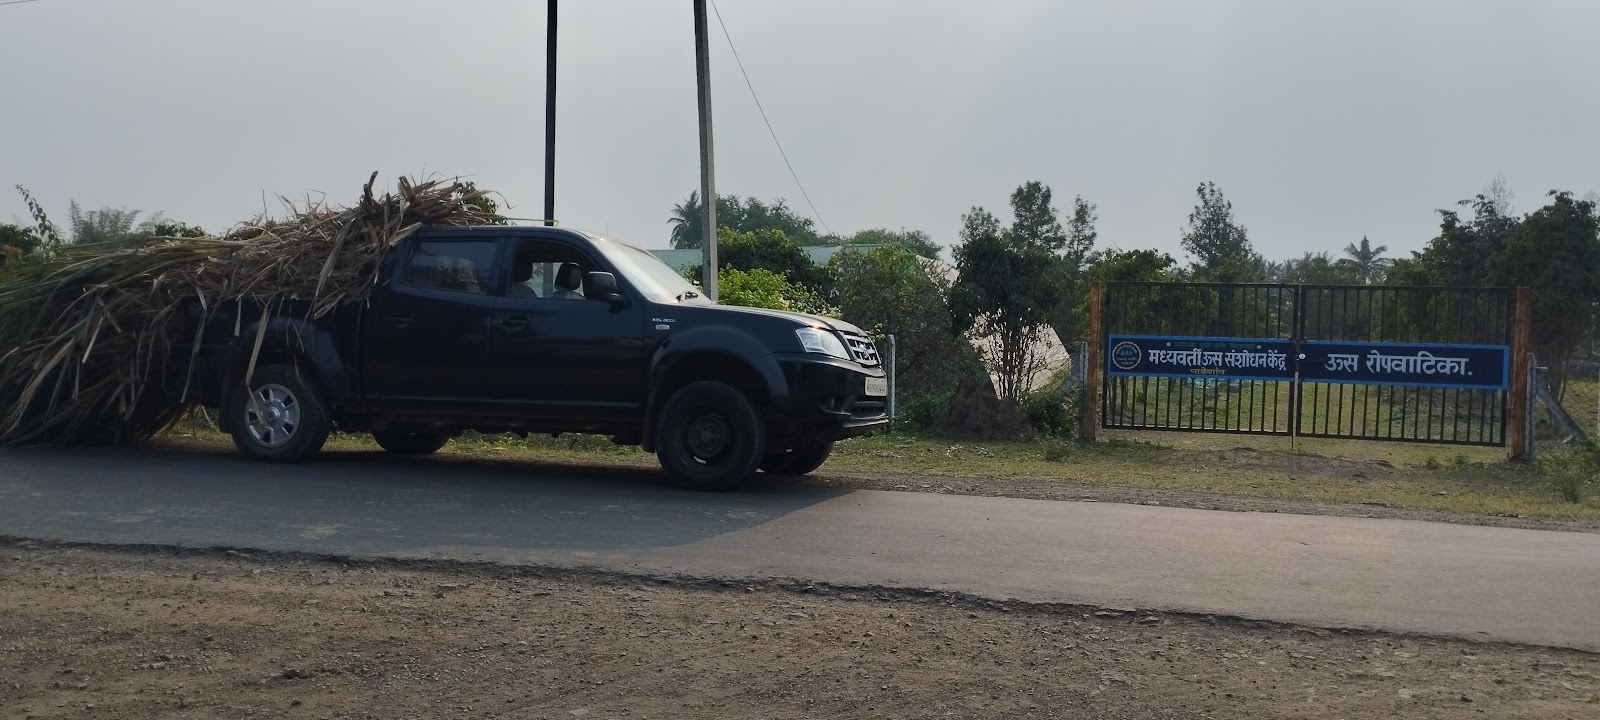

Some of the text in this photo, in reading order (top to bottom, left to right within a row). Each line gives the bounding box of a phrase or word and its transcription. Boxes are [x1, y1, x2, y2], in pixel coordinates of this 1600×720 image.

[1148, 348, 1201, 366] मध्यवर्ती
[1201, 351, 1223, 367] ऊस
[1224, 350, 1267, 368] संशोधन
[1267, 350, 1287, 371] केंद्र
[1325, 353, 1359, 372] ऊस
